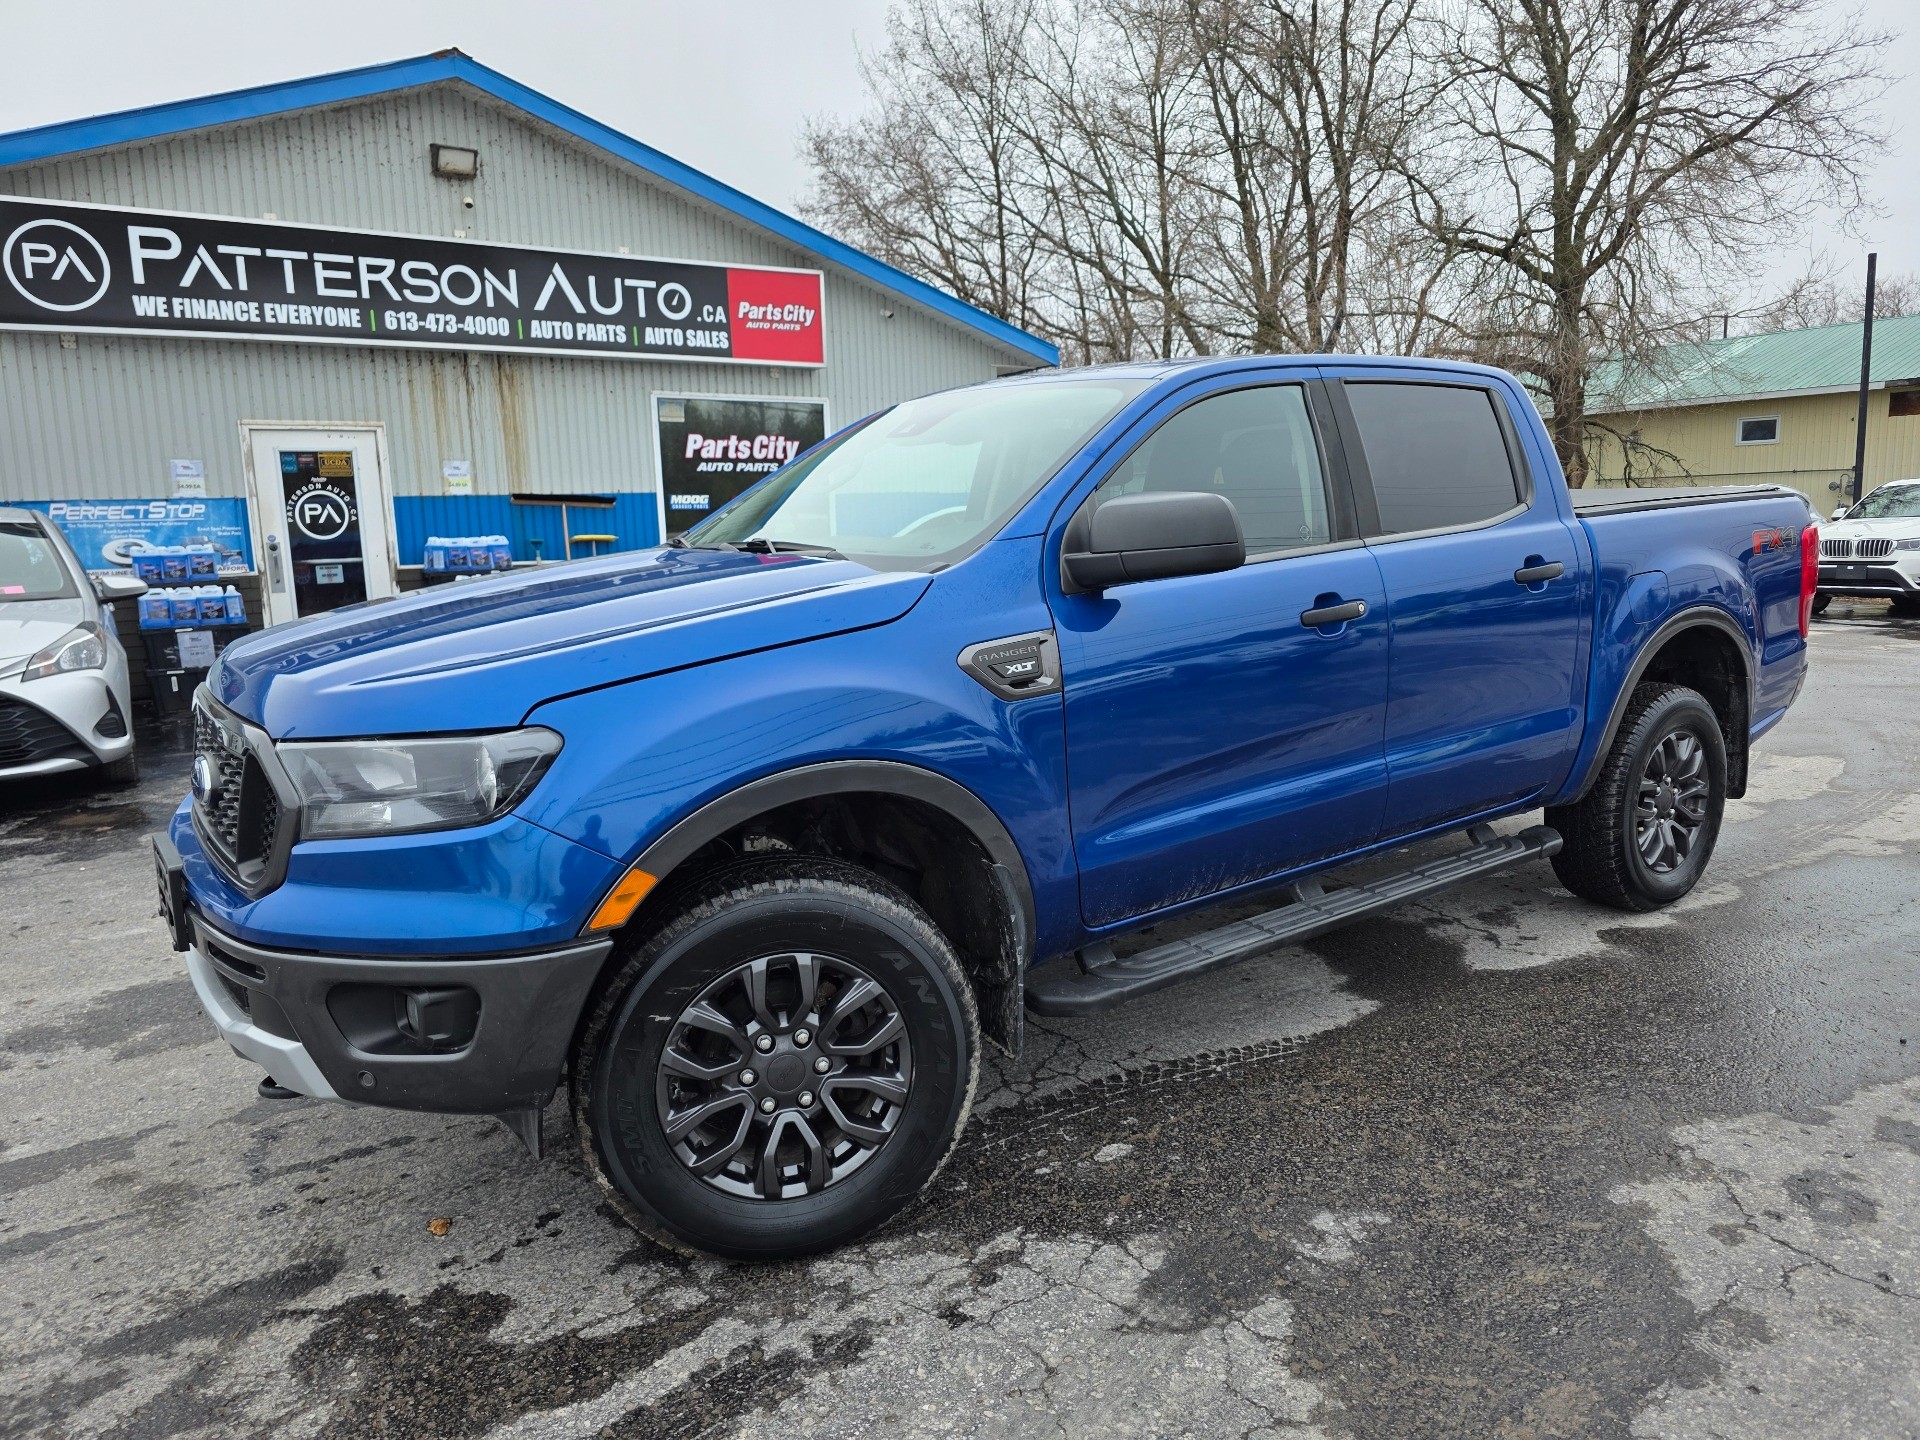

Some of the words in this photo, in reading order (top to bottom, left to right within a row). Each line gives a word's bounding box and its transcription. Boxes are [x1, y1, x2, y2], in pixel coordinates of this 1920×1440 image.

[127, 225, 519, 308] PATTERSON
[132, 295, 169, 317] WE
[172, 298, 261, 323] FINANCE
[264, 304, 361, 328] EVERYONE
[385, 310, 509, 337] 613-473-4000
[530, 319, 573, 341] AUTO
[576, 323, 626, 343] PARTS
[644, 326, 684, 347] AUTO
[686, 329, 729, 349] SALES
[746, 321, 770, 329] AUTO
[772, 322, 801, 331] PARTS
[697, 462, 734, 472] AUTO
[736, 463, 779, 472] PARTS
[287, 482, 321, 523] PATTERSON
[670, 494, 710, 504] MOOG
[1752, 526, 1797, 555] FX4
[978, 645, 1037, 662] RANGER
[1005, 661, 1035, 675] XLT
